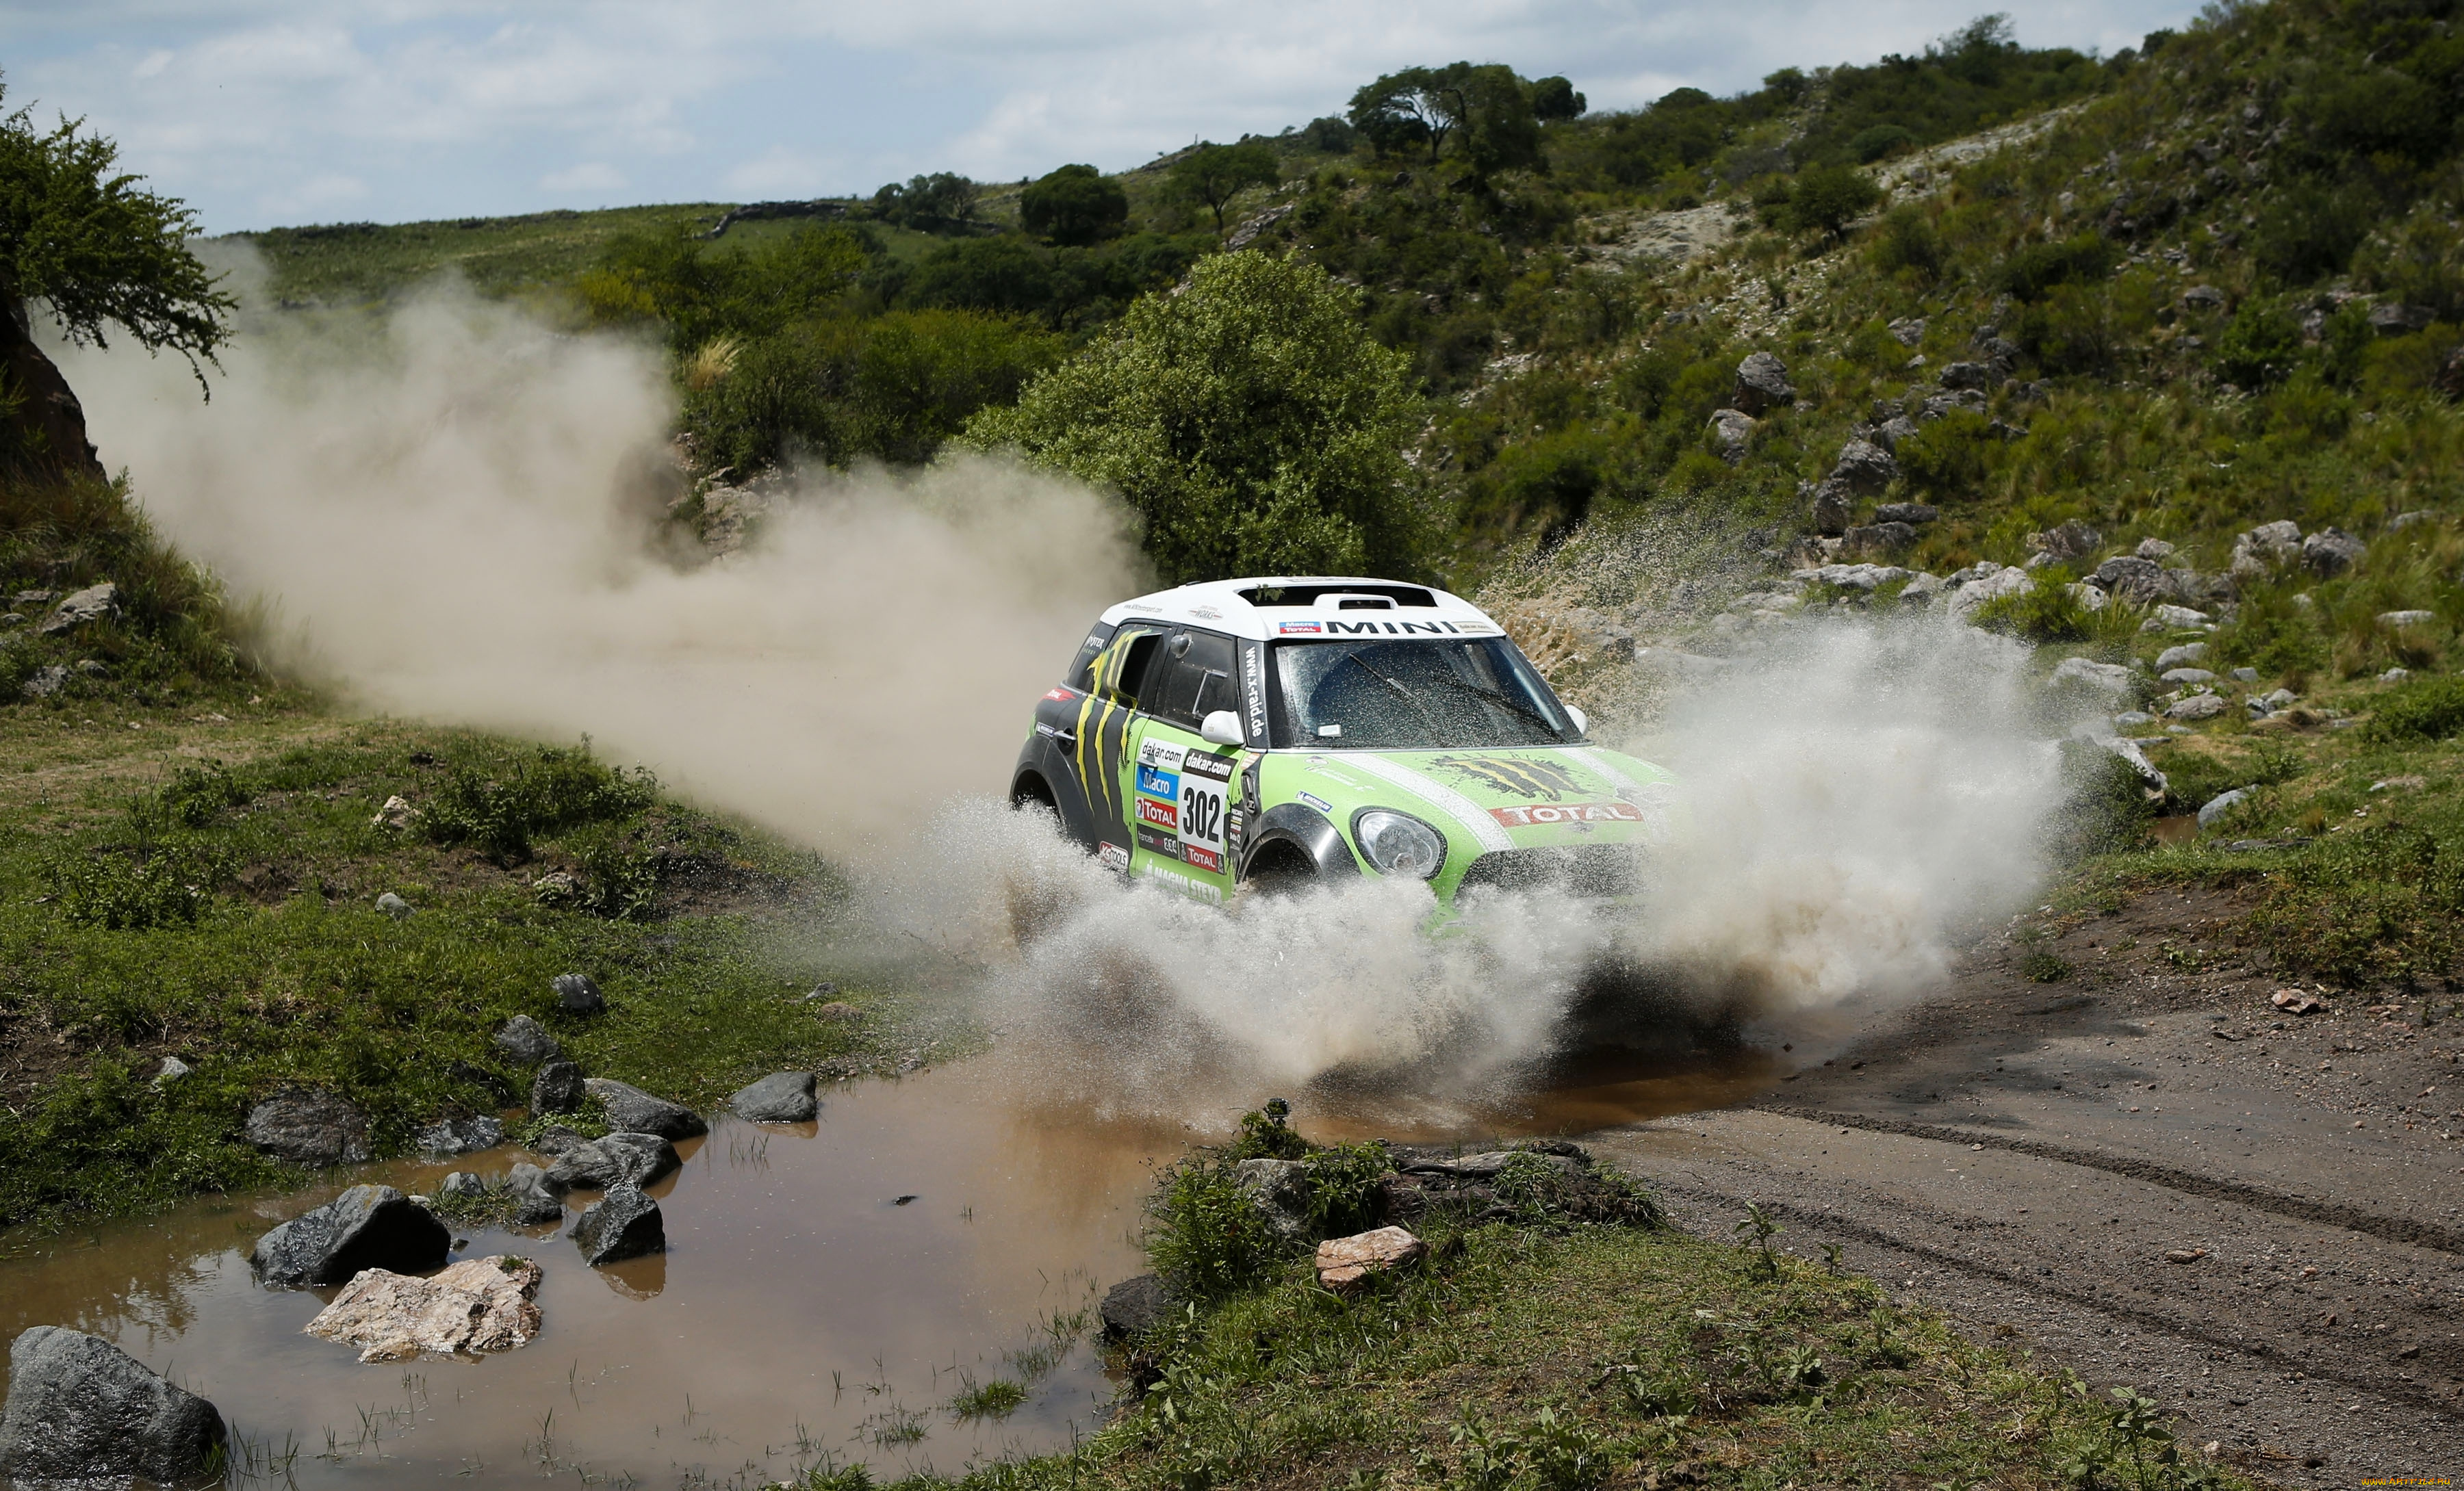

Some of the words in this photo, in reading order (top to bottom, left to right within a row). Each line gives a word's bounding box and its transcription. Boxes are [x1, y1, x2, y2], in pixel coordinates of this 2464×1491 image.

[1326, 621, 1460, 634] MINI
[1245, 646, 1265, 738] www.x-raid.de
[1142, 741, 1182, 763] dakar.com
[1185, 753, 1232, 777] dakar.com
[1143, 772, 1170, 794] Macro
[1304, 794, 1331, 811] MICHELIN
[1144, 802, 1177, 827] TOTAL
[1183, 787, 1220, 843] 302
[1502, 805, 1636, 824] TOTAL
[1188, 847, 1216, 868] TOTAL
[1154, 866, 1189, 894] MAGNA
